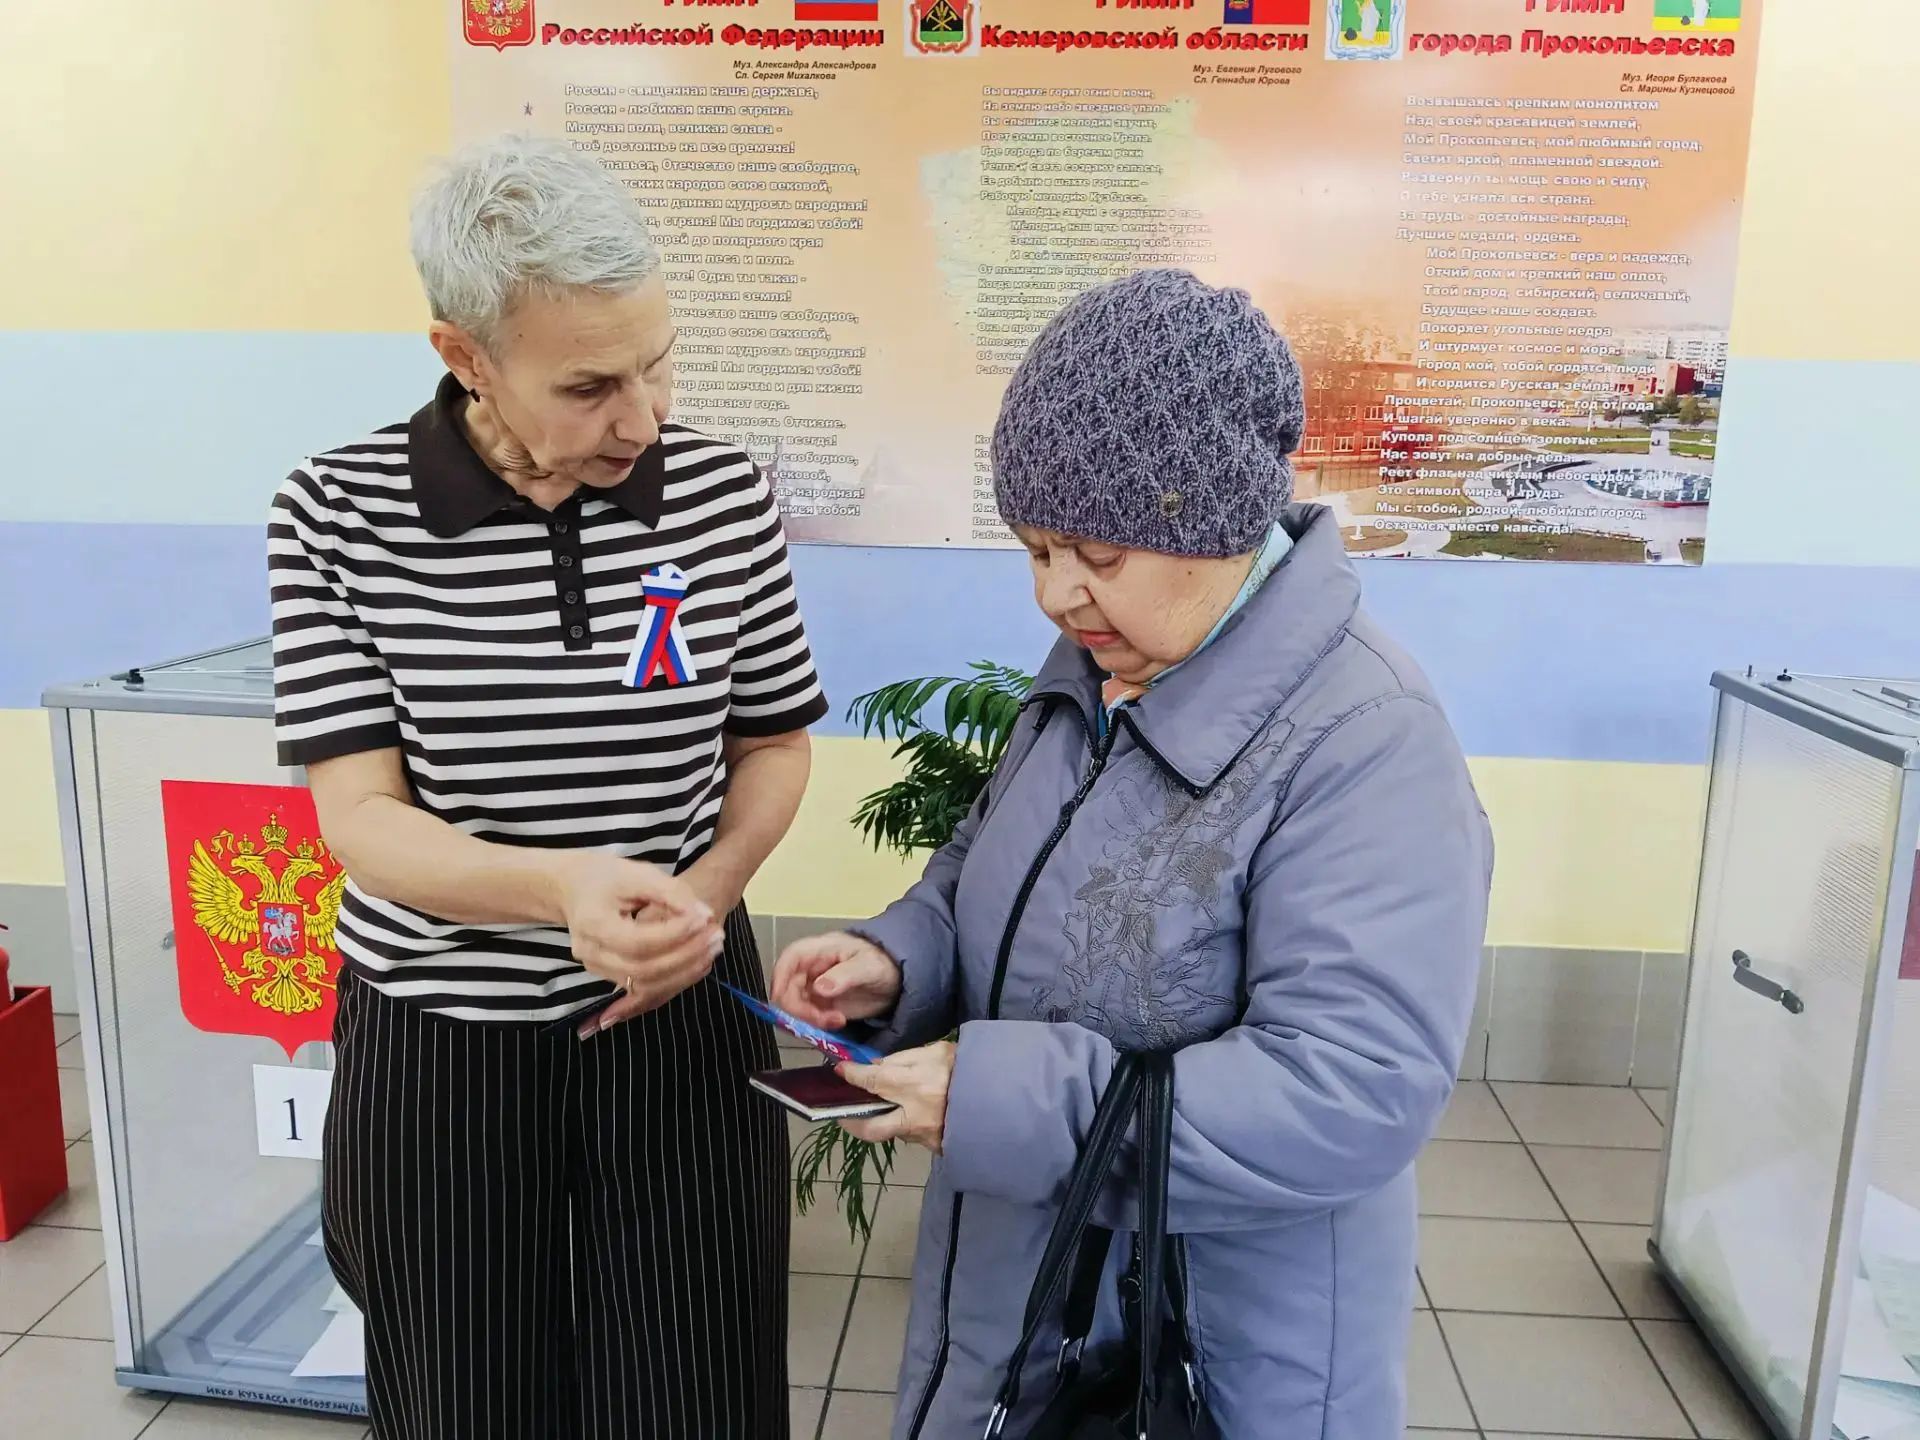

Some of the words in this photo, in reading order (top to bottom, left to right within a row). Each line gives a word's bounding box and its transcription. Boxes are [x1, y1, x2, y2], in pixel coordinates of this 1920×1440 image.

[542, 24, 713, 47] Российской
[721, 25, 884, 50] Федерации
[981, 25, 1178, 52] Кемеровской
[1186, 28, 1308, 52] области
[1521, 30, 1735, 57] Прокопьевска
[733, 61, 753, 70] Муз.
[756, 60, 809, 71] Александра
[812, 61, 876, 70] Александрова
[1193, 65, 1213, 74] Муз.
[1217, 65, 1255, 75] Евгения
[1258, 66, 1302, 75] Лугового
[752, 72, 784, 80] Сергея
[787, 72, 836, 80] Михалкова
[1211, 76, 1255, 85] Геннадия
[1258, 77, 1290, 86] Юрова
[1622, 73, 1642, 82] Муз.
[1645, 74, 1675, 83] Игоря
[1677, 74, 1727, 84] Булгакова
[565, 85, 615, 96] Россия
[628, 86, 707, 98] священная
[711, 86, 748, 96] наша
[1620, 85, 1636, 93] Сл.
[1638, 85, 1676, 95] Марины
[1679, 85, 1735, 96] Кузнецовой
[566, 104, 616, 114] Россия
[628, 103, 694, 116] любимая
[698, 104, 735, 115] наша
[1506, 97, 1569, 110] крепким
[1575, 98, 1658, 110] монолитом
[566, 122, 624, 134] Могучая
[669, 124, 727, 133] великая
[732, 124, 774, 134] слава
[1439, 115, 1482, 127] своей
[1486, 116, 1575, 130] красавицей
[1403, 133, 1434, 144] Мой
[1544, 136, 1574, 147] мой
[1578, 136, 1651, 150] любимый
[603, 142, 676, 153] достоянье
[730, 142, 795, 154] времена!
[661, 160, 734, 172] Отечество
[739, 162, 776, 172] наше
[1509, 154, 1594, 167] пламенной
[666, 180, 725, 191] народов
[729, 181, 766, 190] союз
[1554, 175, 1592, 185] свою
[671, 199, 722, 209] данная
[726, 200, 791, 210] мудрость
[796, 200, 867, 211] народная!
[664, 217, 716, 228] страна!
[720, 217, 742, 226] Мы
[747, 218, 814, 230] гордимся
[817, 218, 863, 229] тобой!
[1478, 213, 1558, 224] достойные
[692, 236, 709, 245] до
[713, 237, 785, 247] полярного
[790, 239, 823, 249] края
[665, 253, 702, 263] наши
[705, 255, 740, 264] леса
[1427, 248, 1456, 259] Мой
[1461, 250, 1557, 261] Прокопьевск
[1570, 252, 1604, 263] вера
[698, 271, 733, 283] Одна
[737, 274, 755, 282] ты
[759, 274, 797, 283] такая
[1425, 266, 1468, 279] Отчий
[1473, 268, 1501, 279] дом
[1520, 268, 1580, 281] крепкий
[690, 291, 739, 302] родная
[743, 292, 791, 302] земля!
[1424, 286, 1458, 297] Твой
[740, 309, 777, 320] наше
[1422, 304, 1486, 317] Будущее
[1491, 306, 1529, 316] наше
[729, 329, 766, 337] союз
[1421, 323, 1488, 336] Покоряет
[1492, 324, 1563, 337] угольные
[673, 344, 723, 354] данная
[726, 346, 791, 356] мудрость
[795, 347, 865, 358] народная!
[1434, 343, 1502, 355] штурмует
[1508, 343, 1561, 354] космос
[721, 363, 745, 373] Мы
[748, 364, 813, 376] гордимся
[817, 364, 862, 375] тобой!
[1418, 360, 1460, 372] Город
[1502, 360, 1544, 372] тобой
[1548, 362, 1613, 375] гордятся
[698, 381, 723, 391] для
[727, 382, 772, 392] мечты
[787, 383, 812, 393] для
[815, 384, 862, 393] жизни
[1431, 379, 1496, 392] гордится
[1500, 379, 1559, 392] Русская
[677, 398, 751, 409] открывают
[1574, 400, 1597, 411] год
[1602, 401, 1618, 411] от
[1621, 401, 1654, 412] года
[679, 416, 714, 424] наша
[718, 417, 781, 427] верность
[1398, 414, 1443, 425] шагай
[1447, 415, 1516, 427] уверенно
[719, 434, 742, 442] так
[745, 433, 784, 445] будет
[787, 434, 837, 446] всегда!
[1382, 431, 1432, 444] Купола
[1438, 434, 1464, 445] под
[1381, 449, 1408, 460] Нас
[1412, 450, 1452, 463] зовут
[1456, 452, 1474, 460] на
[796, 487, 864, 499] народная!
[1406, 486, 1461, 497] символ
[1465, 487, 1502, 498] мира
[818, 505, 860, 515] тобой!
[1526, 505, 1597, 518] любимый
[1449, 522, 1499, 533] вместе
[1504, 523, 1573, 535] навсегда!
[283, 1098, 302, 1141] 1
